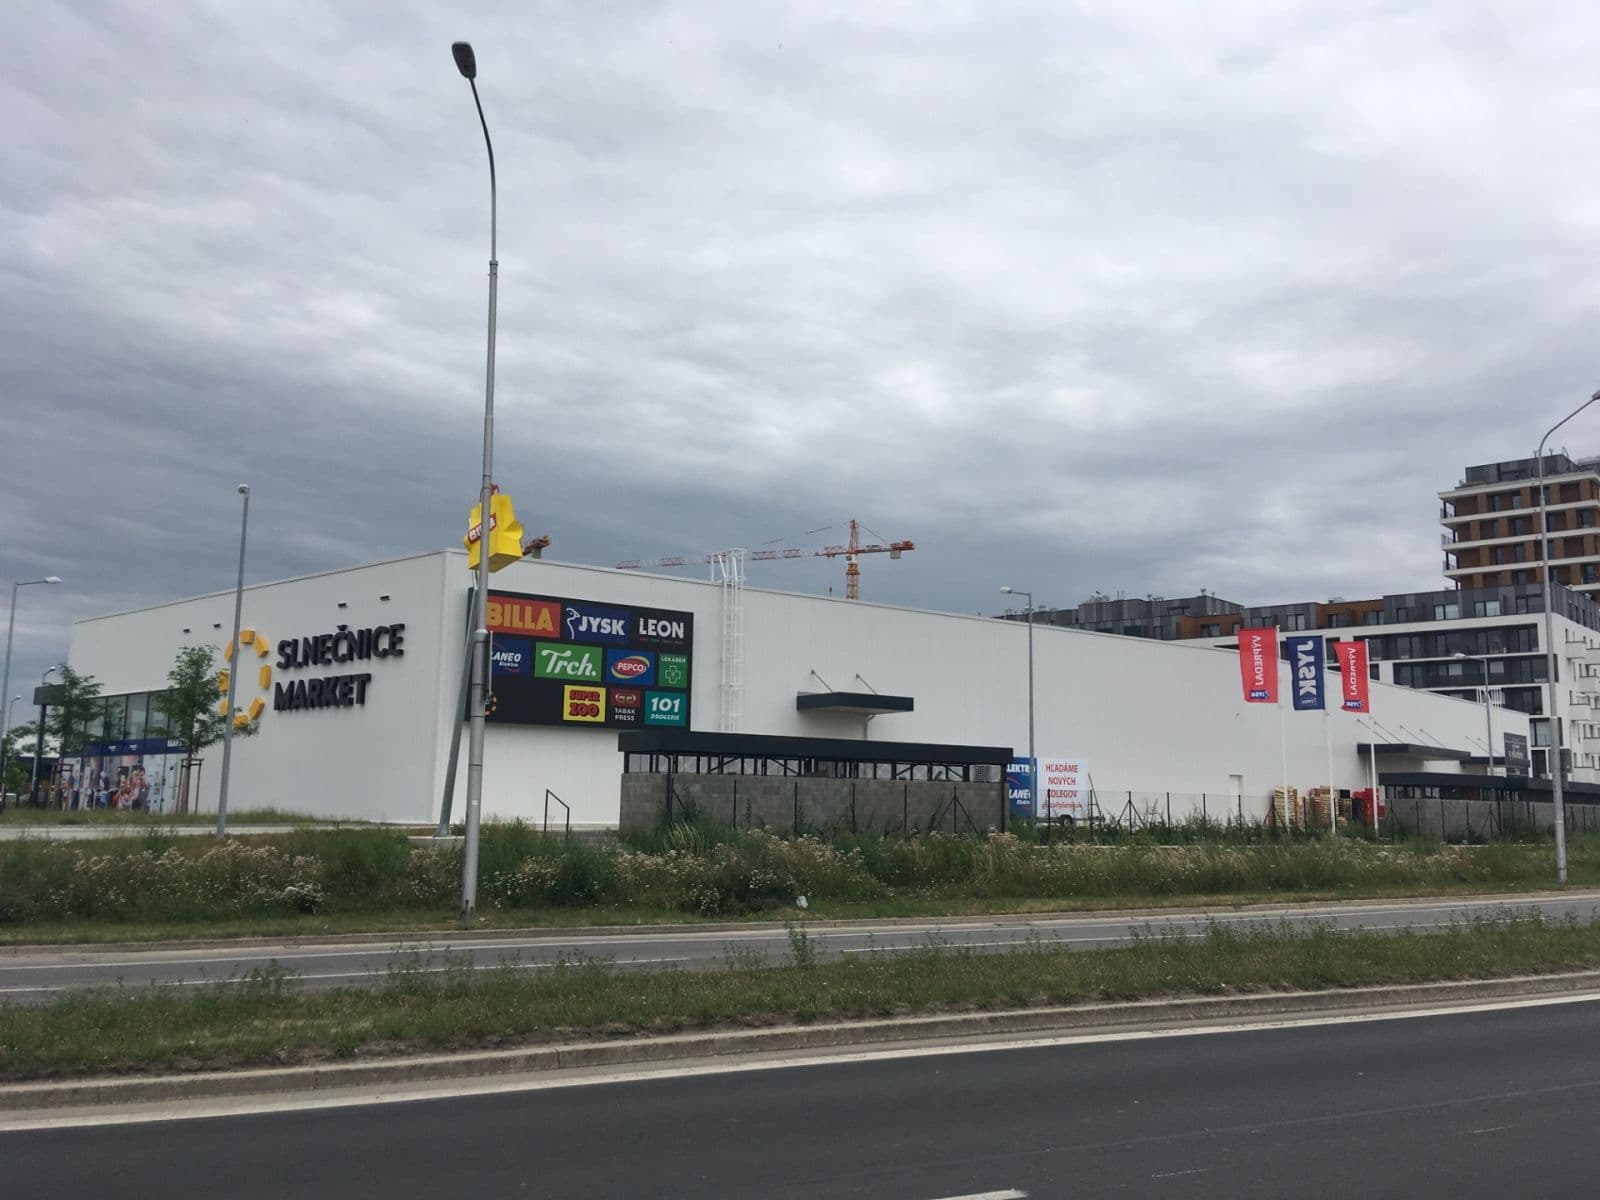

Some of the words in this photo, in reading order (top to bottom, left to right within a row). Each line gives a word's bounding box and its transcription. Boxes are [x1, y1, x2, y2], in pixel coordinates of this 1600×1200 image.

[469, 517, 495, 541] BIA
[488, 602, 554, 632] BILLA
[578, 615, 625, 636] JYSK
[639, 617, 685, 640] LEON
[276, 623, 405, 670] SLNEČNICE
[616, 662, 644, 673] PEPCO
[273, 672, 372, 711] MARKET
[569, 690, 600, 702] SUPER
[569, 703, 600, 717] ZOO
[651, 697, 680, 713] 101
[650, 713, 680, 721] DROGERIE
